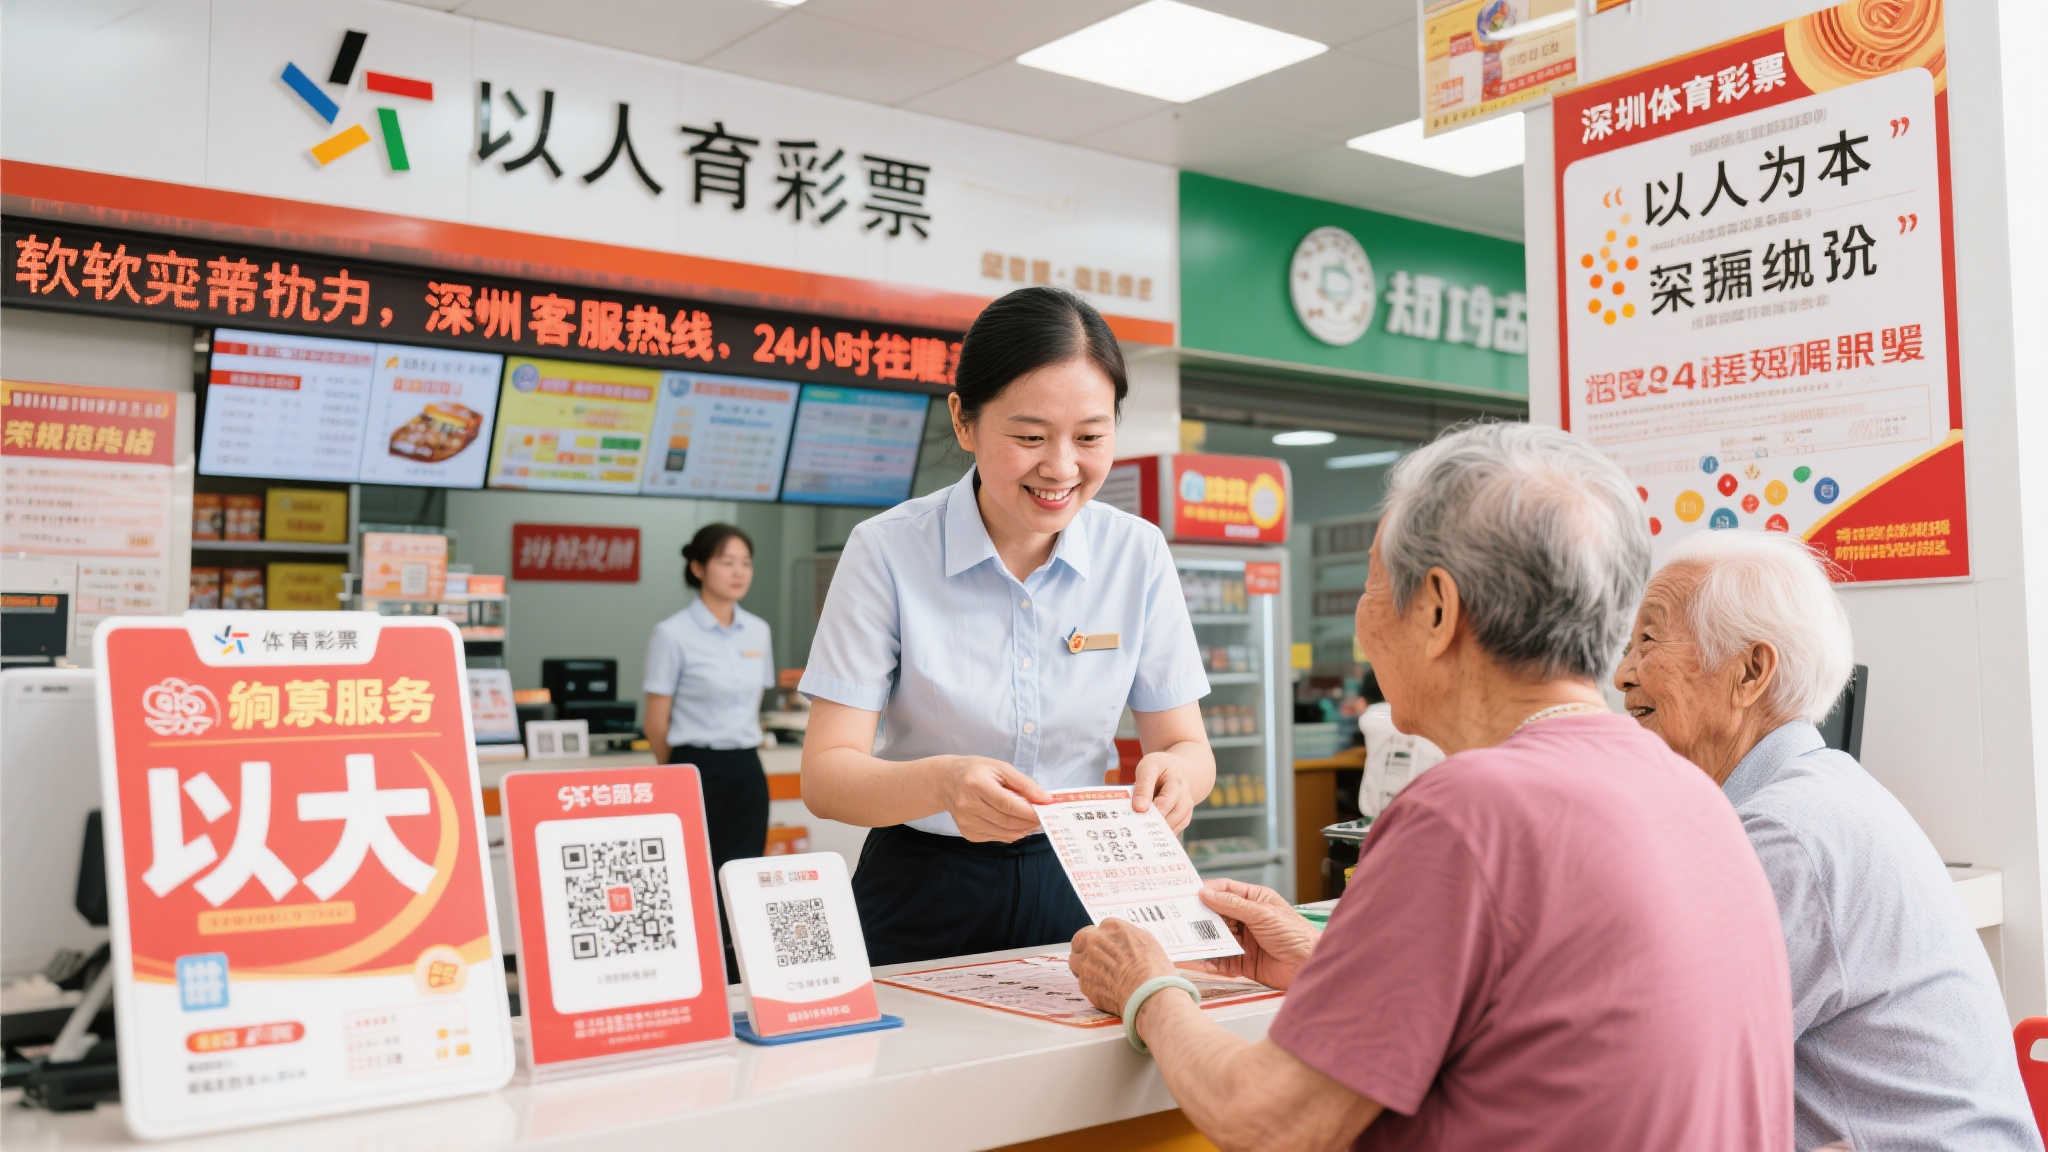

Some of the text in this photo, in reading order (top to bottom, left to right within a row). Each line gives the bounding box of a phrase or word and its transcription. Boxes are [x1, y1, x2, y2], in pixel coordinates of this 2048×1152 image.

[475, 81, 932, 240] 以人育彩票
[1581, 52, 1787, 145] 深圳体育彩票
[142, 754, 438, 907] 以大
